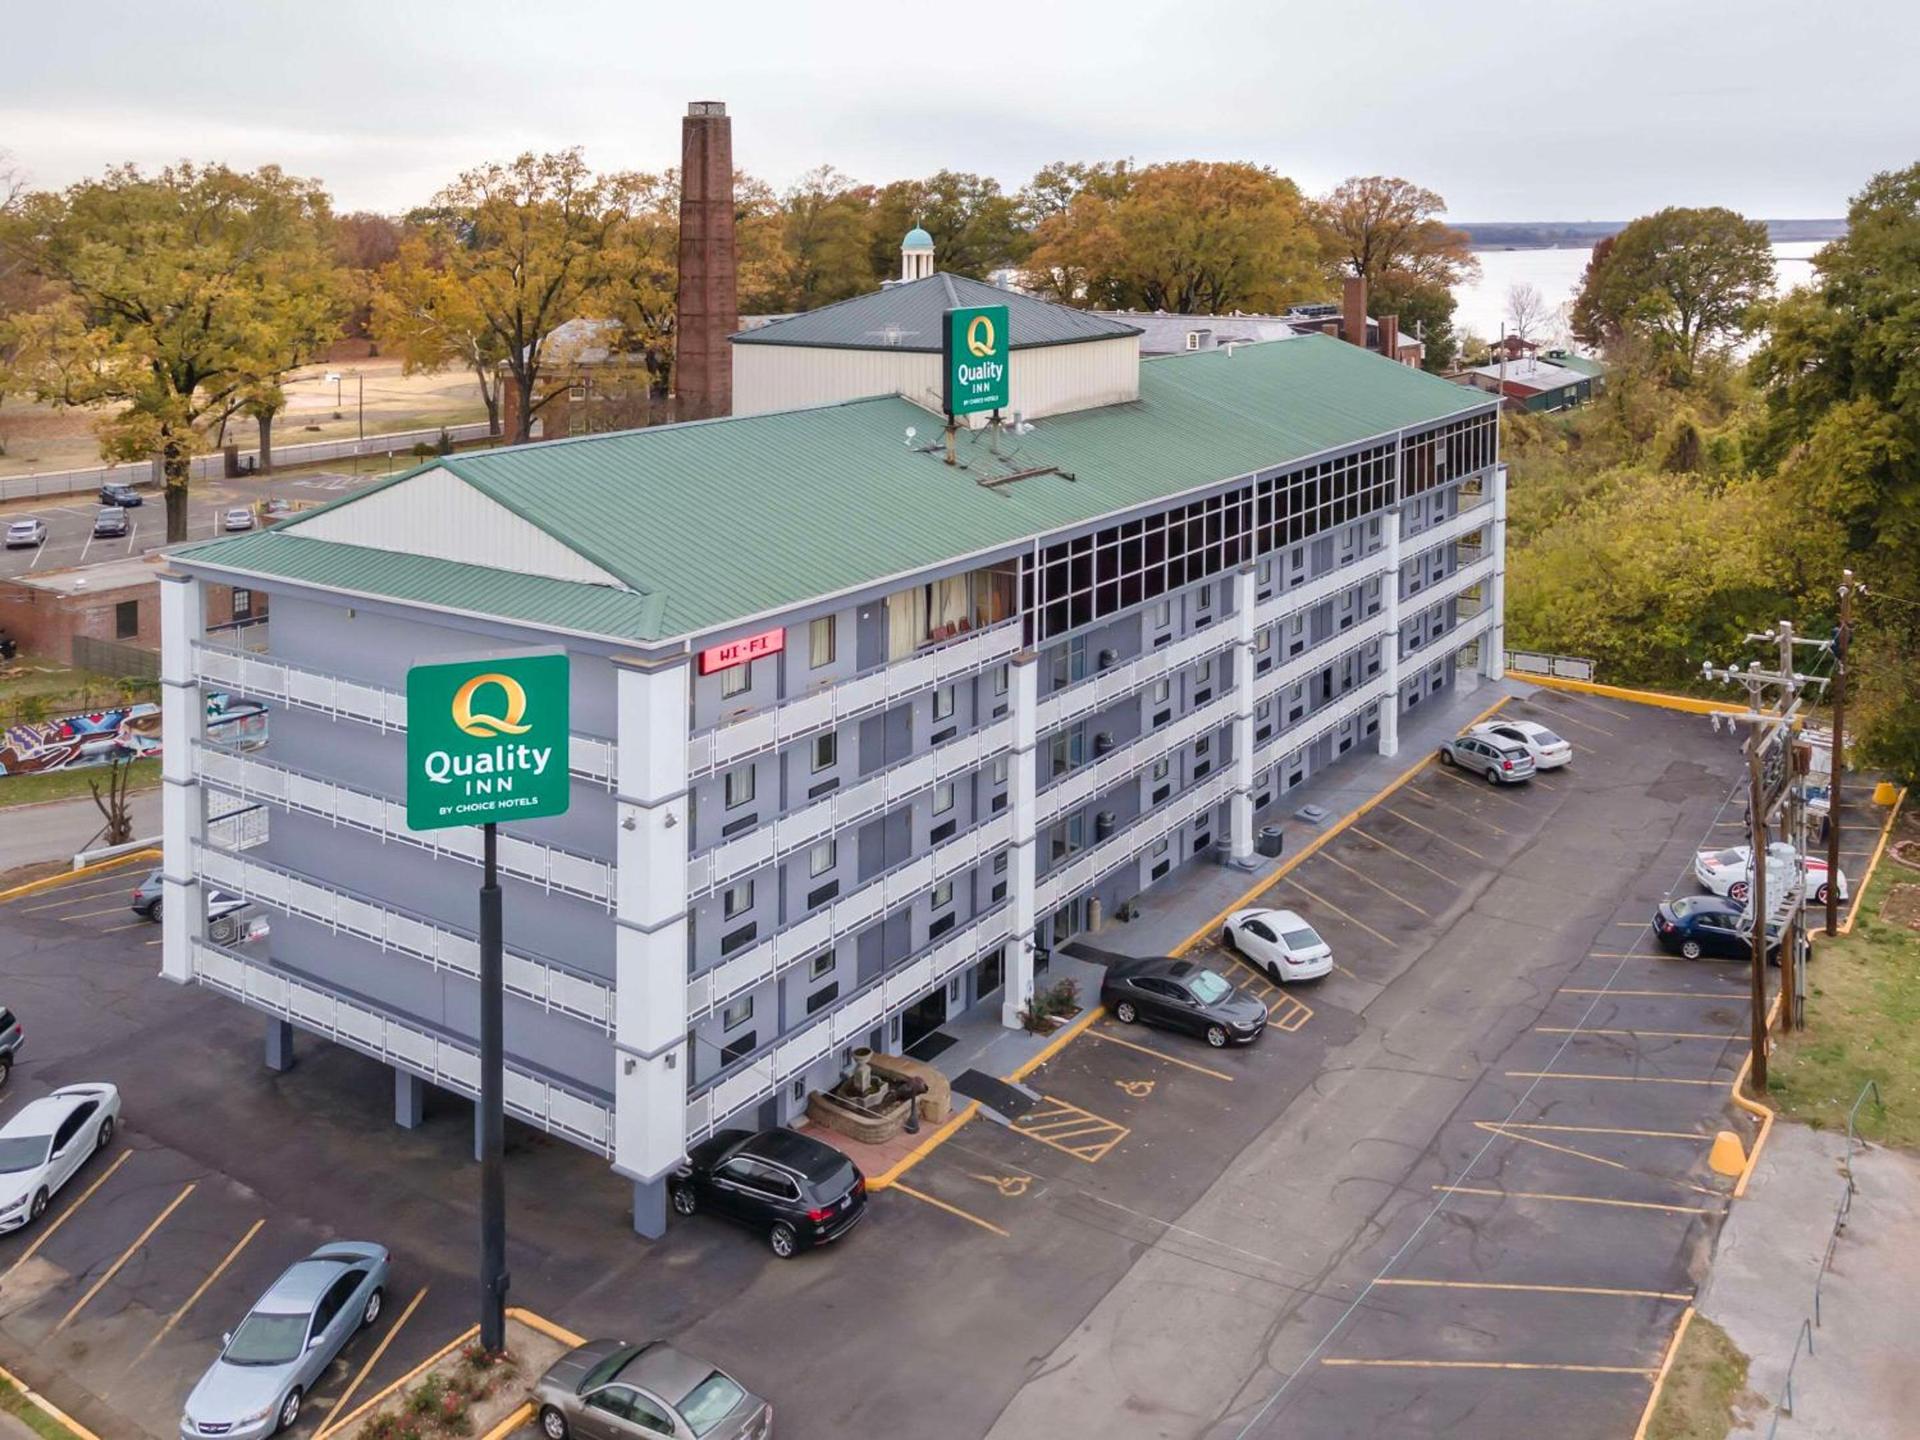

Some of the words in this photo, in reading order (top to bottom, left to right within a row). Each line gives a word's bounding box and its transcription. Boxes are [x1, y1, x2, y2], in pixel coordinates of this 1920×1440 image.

[968, 316, 996, 357] Q
[958, 361, 1003, 386] Quality
[972, 381, 990, 394] INN
[452, 673, 533, 738] Q
[424, 744, 552, 784] Quality
[465, 776, 512, 796] INN
[439, 806, 453, 815] BY
[455, 801, 495, 813] CHOICE
[498, 796, 539, 808] HOTELS
